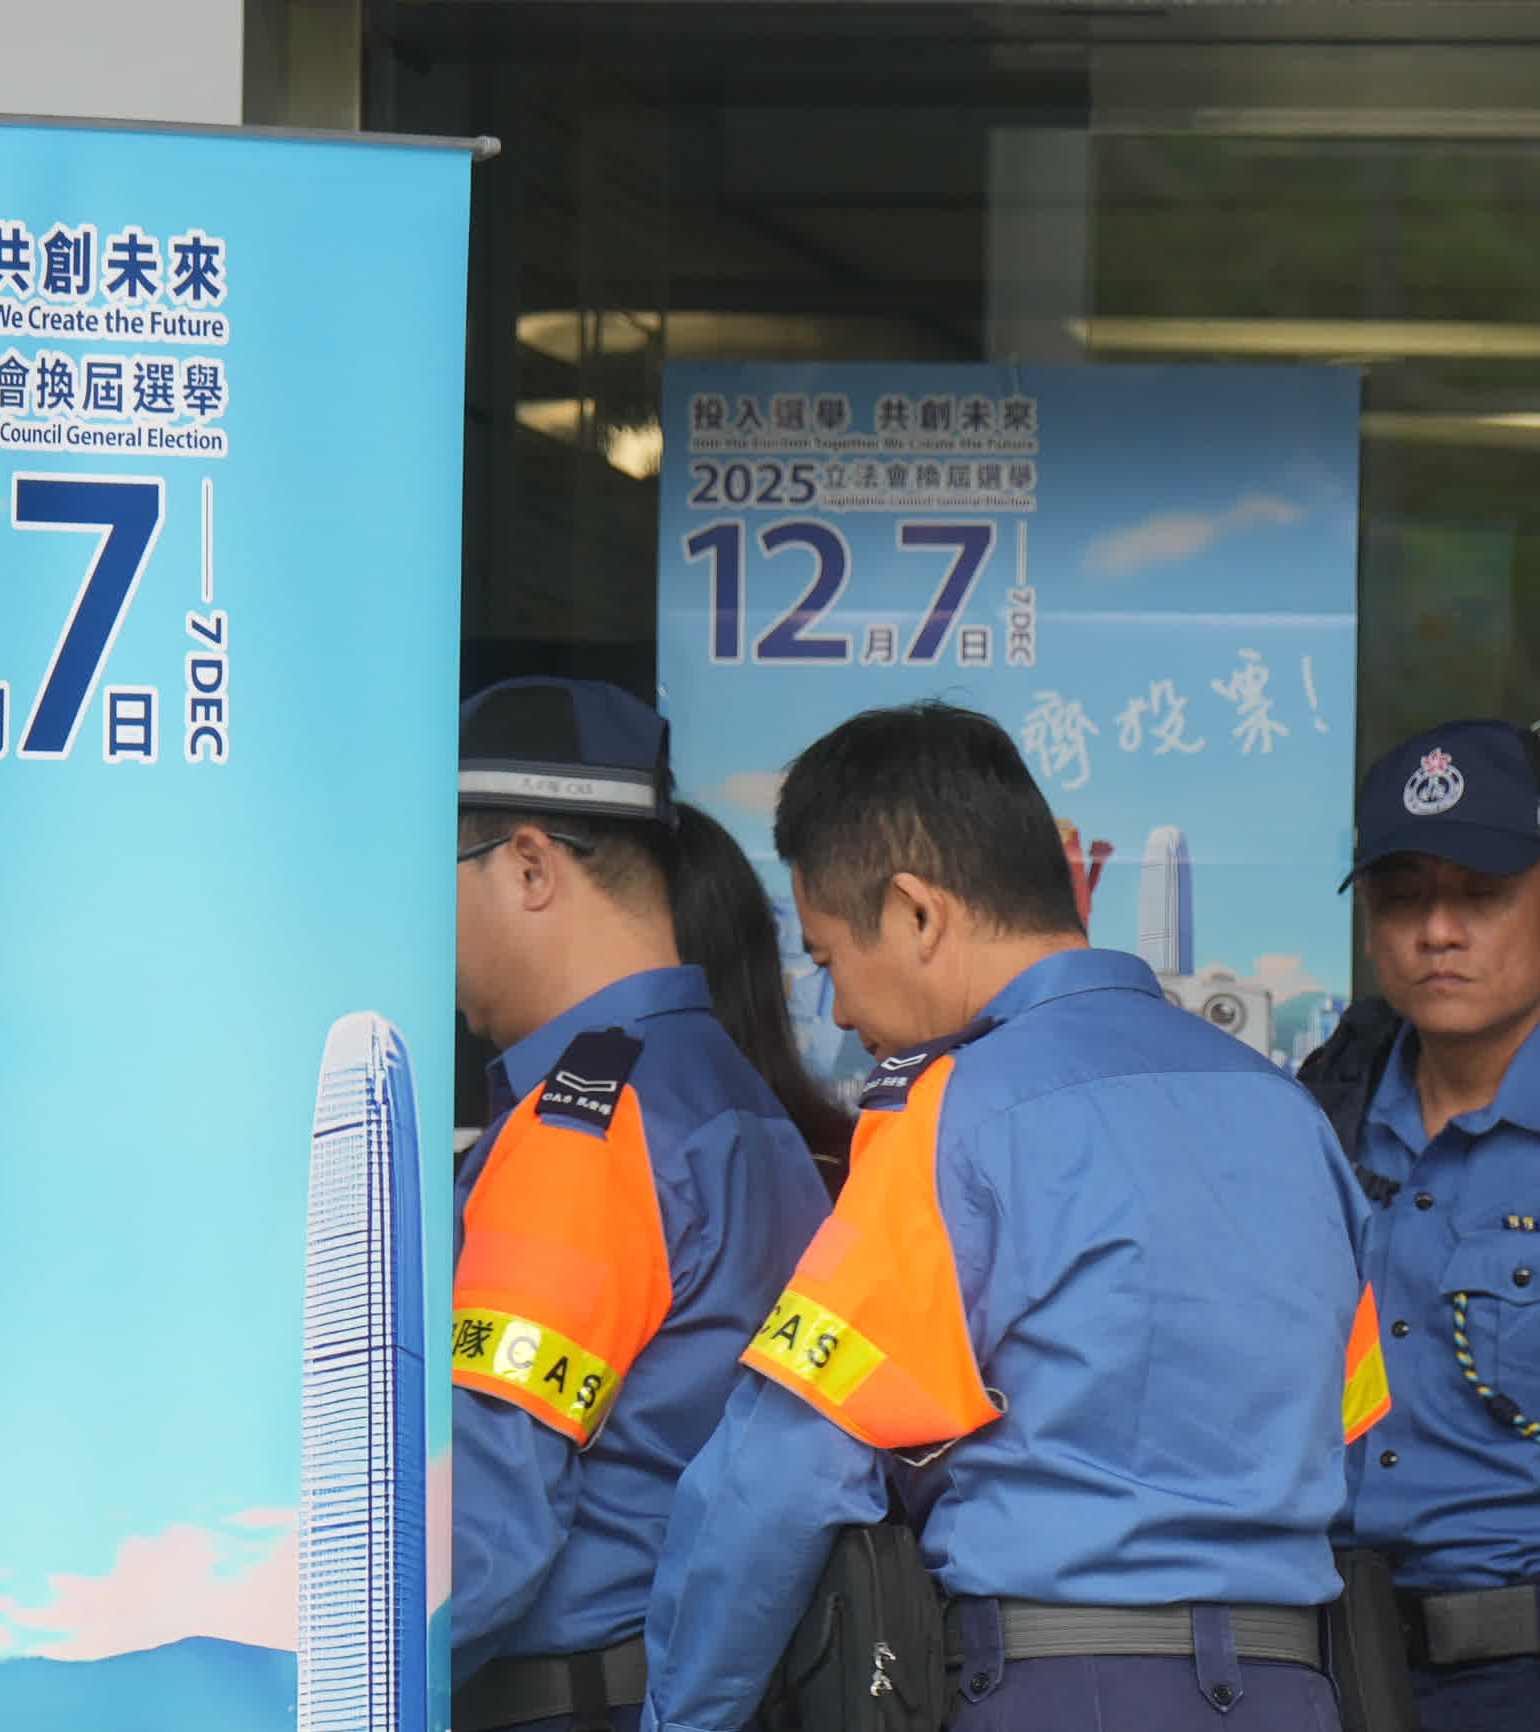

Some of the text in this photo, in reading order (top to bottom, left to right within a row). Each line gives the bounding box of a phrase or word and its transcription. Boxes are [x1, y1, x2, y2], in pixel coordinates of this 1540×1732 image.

[27, 305, 99, 332] Create
[104, 309, 145, 335] the
[149, 310, 225, 338] Future
[0, 422, 62, 445] Council
[66, 424, 142, 447] General
[146, 427, 223, 451] Election
[691, 463, 817, 504] 2025
[190, 617, 223, 758] 7 DEC
[453, 1319, 602, 1409] 隊 CAS
